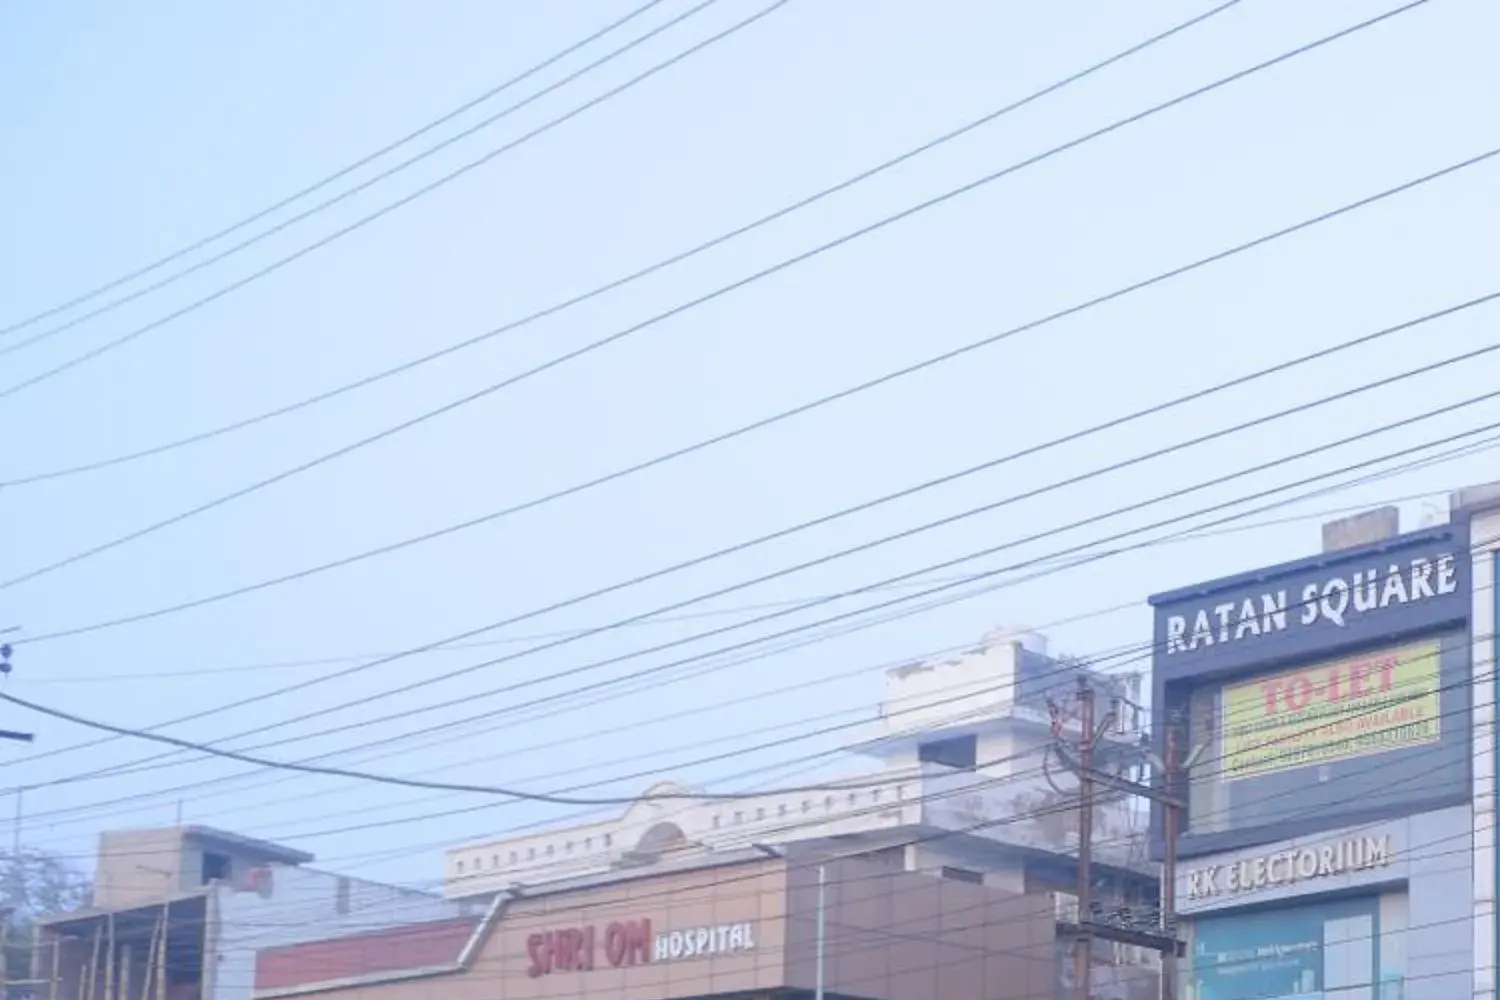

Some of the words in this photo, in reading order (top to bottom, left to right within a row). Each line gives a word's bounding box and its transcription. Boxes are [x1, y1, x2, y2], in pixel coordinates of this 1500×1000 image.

[1167, 590, 1287, 655] RATAN
[1301, 554, 1458, 627] SQUARE
[1260, 654, 1398, 717] TO-LET
[1186, 867, 1218, 899] RK
[1226, 835, 1393, 892] ELECTORIUM
[604, 918, 652, 968] OM
[655, 922, 754, 962] HOSPITAL
